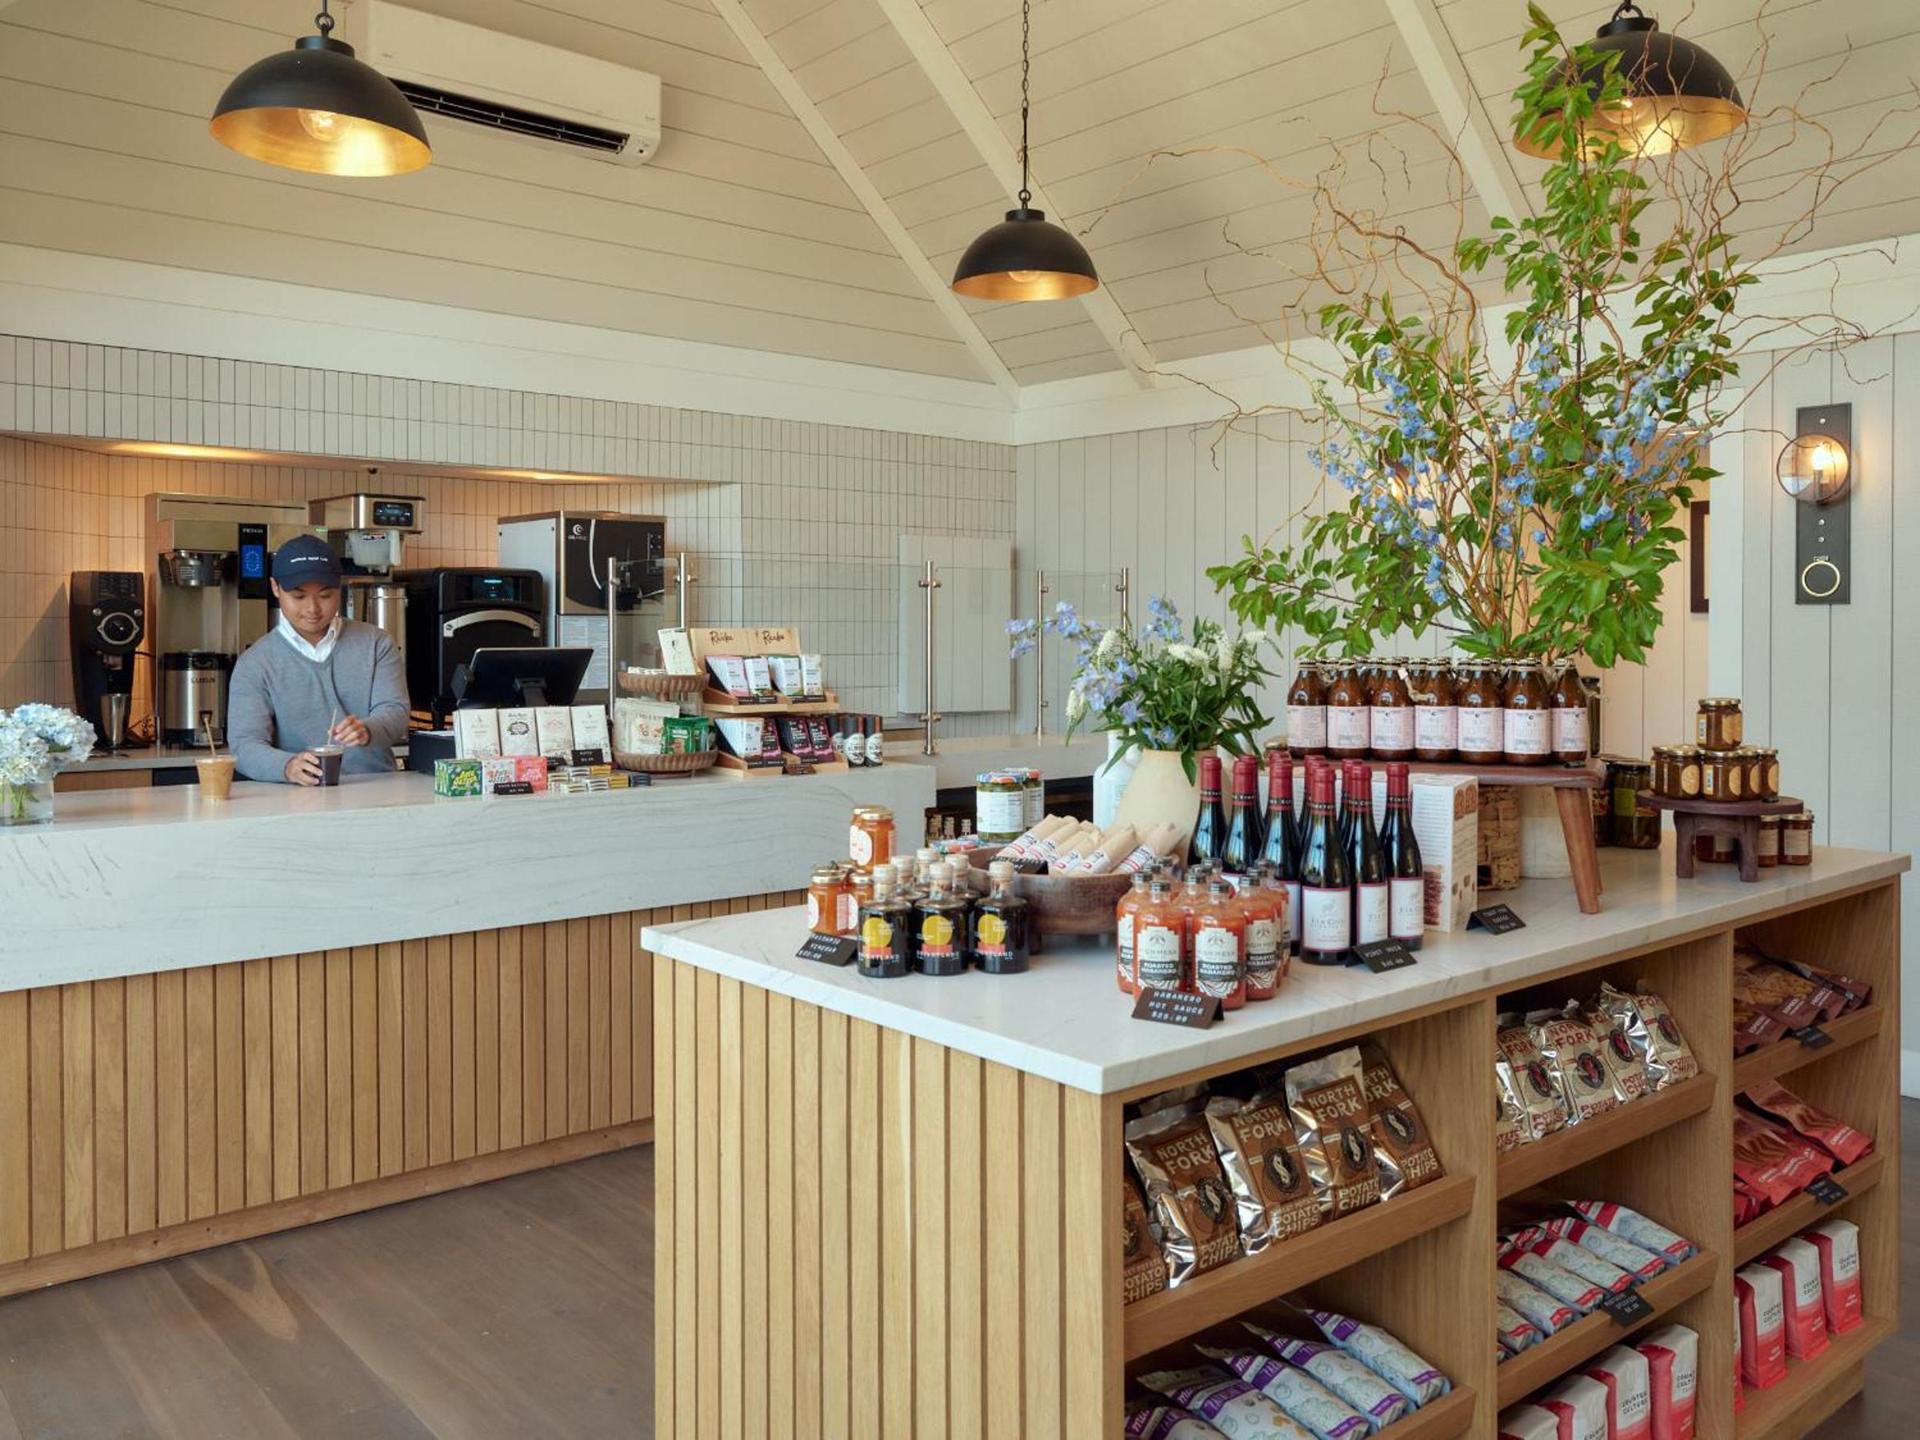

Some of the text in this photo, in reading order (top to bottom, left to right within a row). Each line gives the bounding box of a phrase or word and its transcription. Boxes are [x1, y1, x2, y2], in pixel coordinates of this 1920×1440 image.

[1148, 1001, 1167, 1010] HOT
[1153, 990, 1202, 1004] HABANERO
[1554, 1028, 1595, 1050] FORK
[1364, 1065, 1390, 1087] RTH
[1307, 1082, 1356, 1109] NORTH
[1315, 1095, 1362, 1122] FORK
[1239, 1118, 1288, 1143] FORK
[1155, 1131, 1209, 1161] NORTH
[1165, 1144, 1215, 1175] FORK
[1273, 1203, 1321, 1226] POTATO
[1124, 1266, 1162, 1289] OTATO
